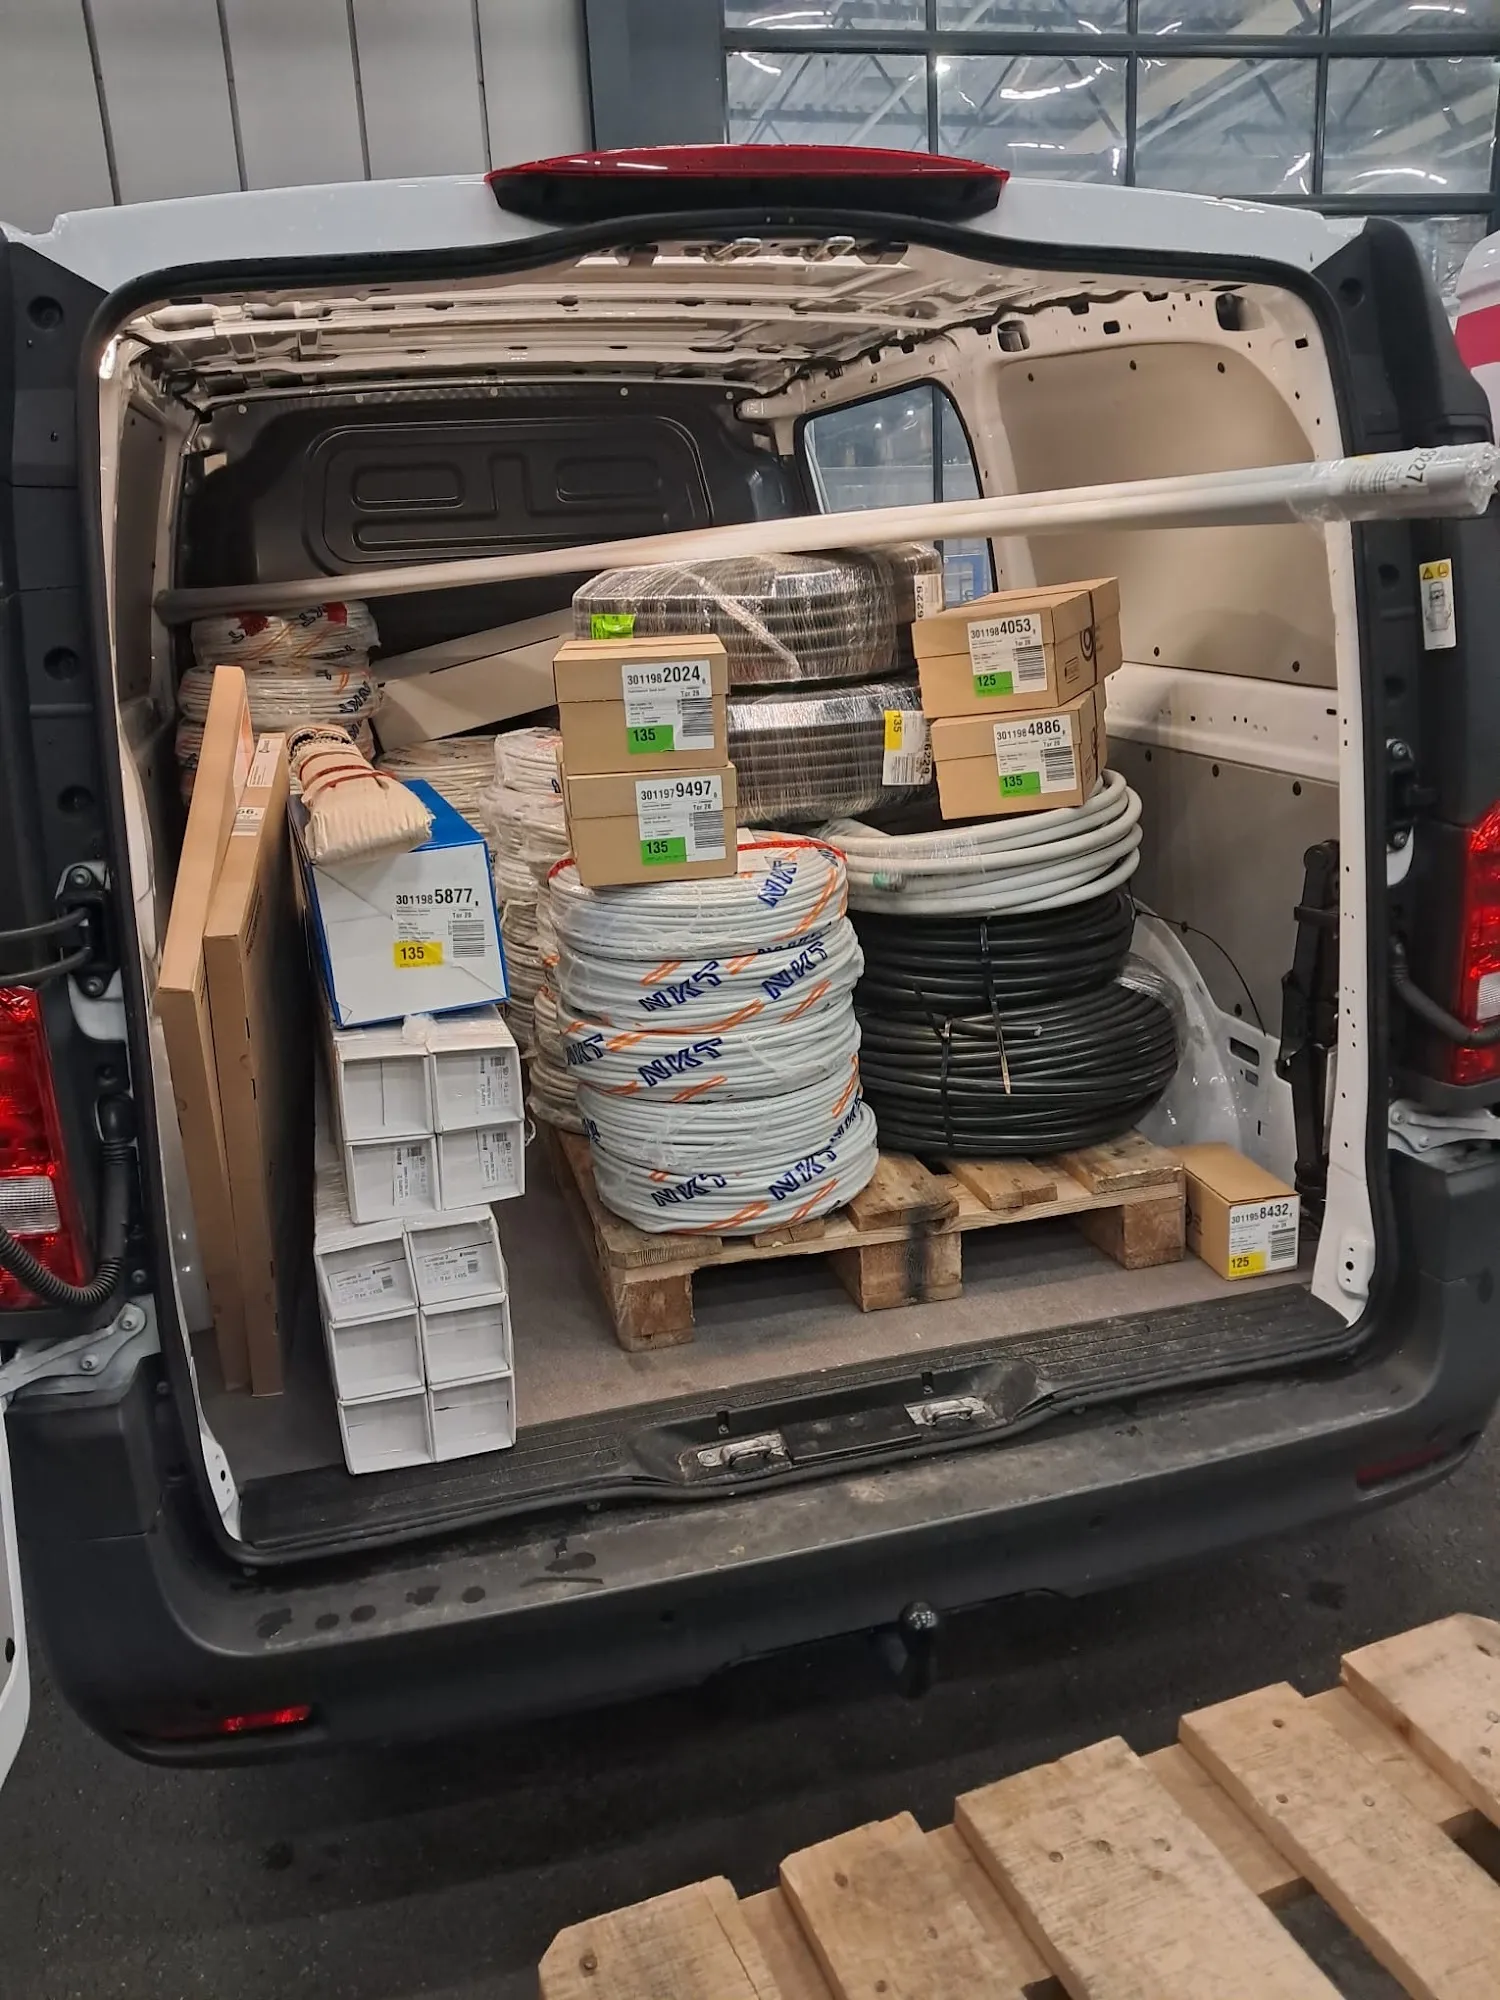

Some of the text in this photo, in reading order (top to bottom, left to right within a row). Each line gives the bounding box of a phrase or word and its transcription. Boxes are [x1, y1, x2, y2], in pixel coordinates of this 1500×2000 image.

[977, 674, 996, 686] 125
[633, 728, 656, 742] 135
[1003, 775, 1023, 788] 135
[646, 840, 669, 854] 135
[400, 946, 425, 960] 135
[761, 941, 829, 1000] NKT
[638, 960, 723, 1012] NKT
[637, 1037, 724, 1087] NKT
[768, 1148, 838, 1201] NKT
[651, 1173, 728, 1208] NKT
[1231, 1256, 1250, 1269] 125
